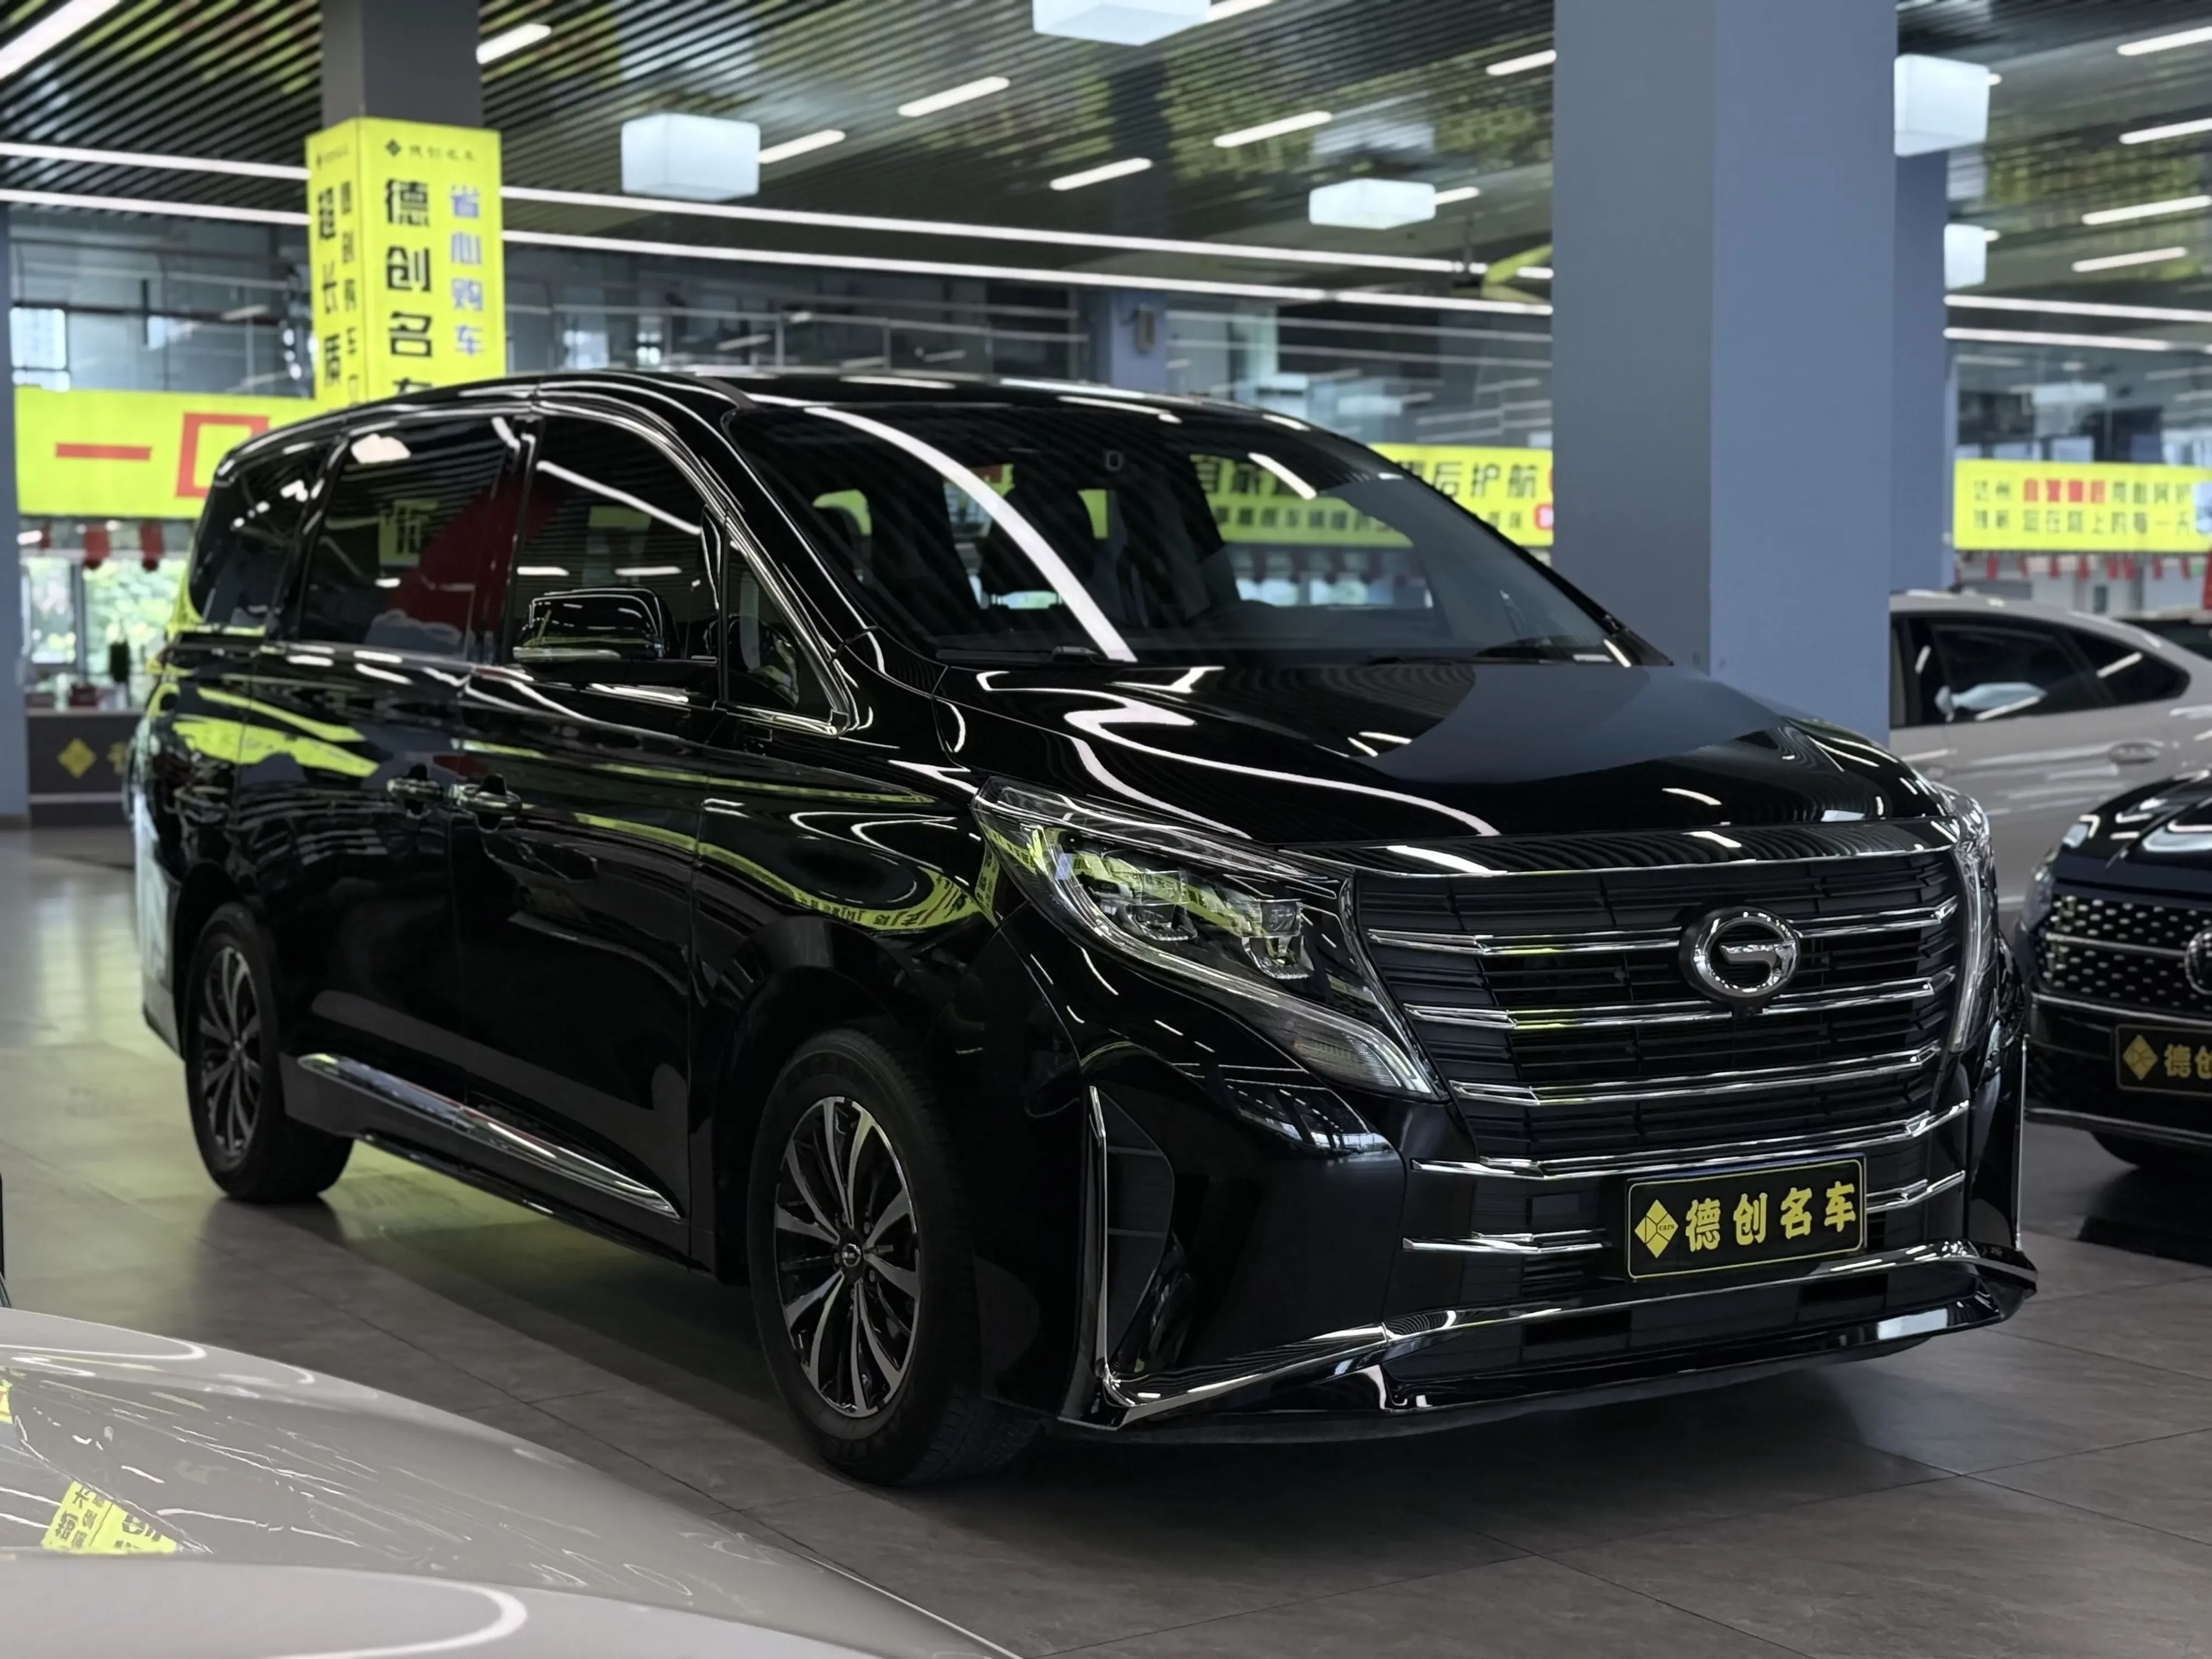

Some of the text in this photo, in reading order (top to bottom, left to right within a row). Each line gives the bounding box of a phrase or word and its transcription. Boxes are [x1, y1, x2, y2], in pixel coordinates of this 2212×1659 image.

[450, 185, 484, 356] 省心购车
[1685, 1181, 1857, 1253] 德创名车
